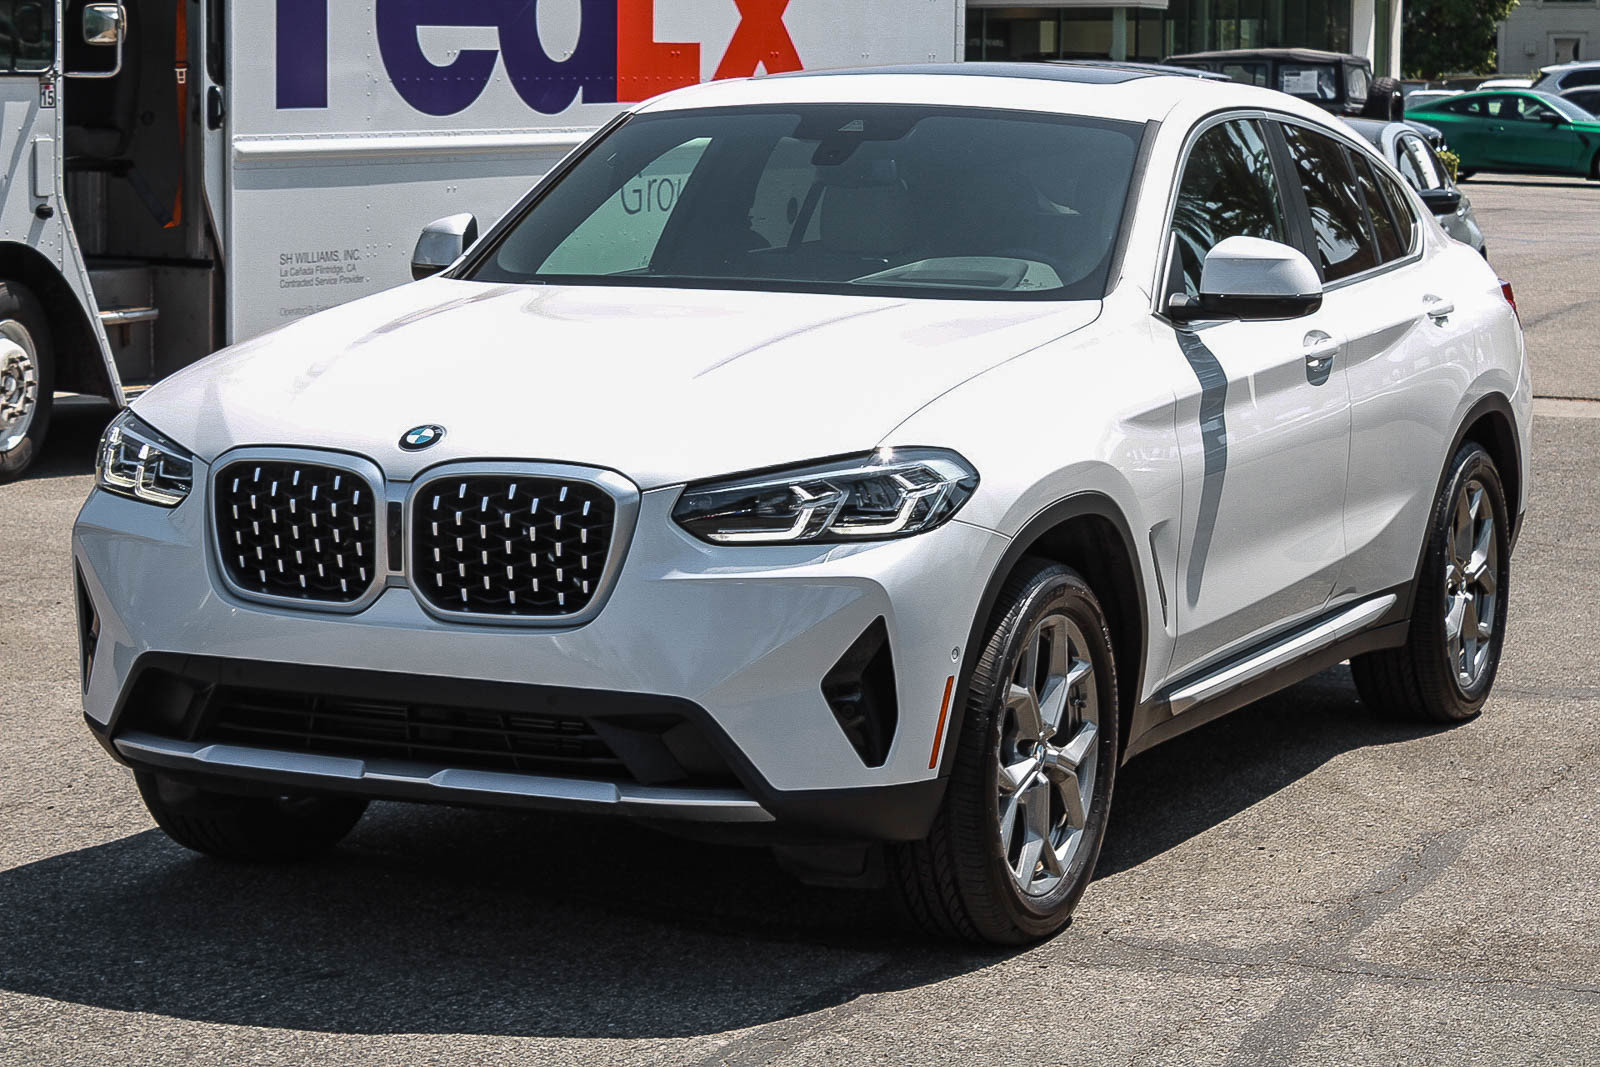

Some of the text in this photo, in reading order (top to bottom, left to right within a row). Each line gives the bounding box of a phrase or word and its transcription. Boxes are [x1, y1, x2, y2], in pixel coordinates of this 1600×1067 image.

[42, 90, 54, 106] 15
[280, 249, 362, 265] SH WILLIAMS, INC.
[280, 269, 289, 277] La
[347, 263, 357, 272] CA
[280, 275, 364, 289] Contracted Service Provider
